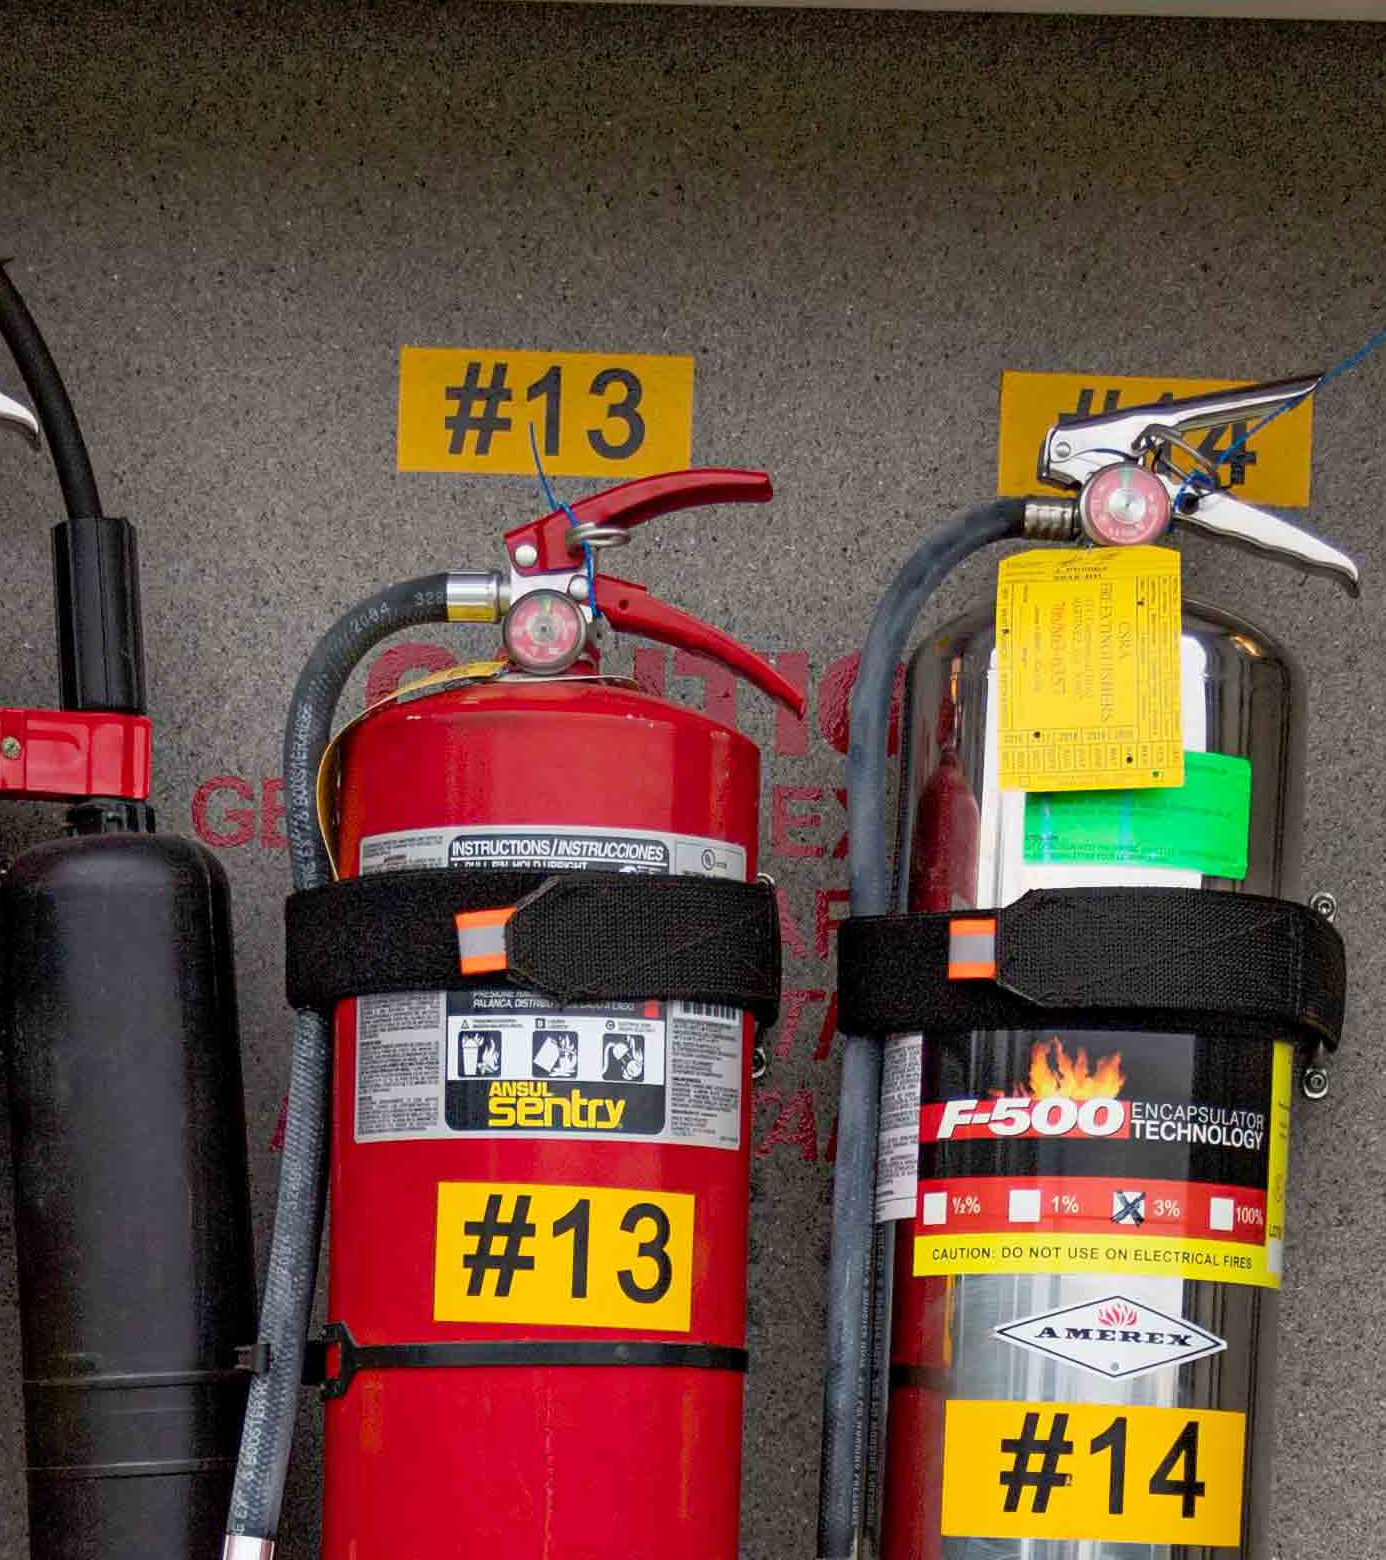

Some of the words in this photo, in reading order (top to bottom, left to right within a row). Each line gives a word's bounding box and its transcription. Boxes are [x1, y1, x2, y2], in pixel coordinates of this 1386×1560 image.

[444, 361, 646, 460] #13
[488, 1081, 551, 1098] ANSUL
[936, 1096, 1127, 1140] F-500
[1131, 1102, 1265, 1128] ENCAPSULATOR
[1130, 1120, 1263, 1150] TECHNOLOGY
[1051, 1195, 1080, 1214] 1%
[1153, 1199, 1181, 1217] 3%
[1235, 1206, 1263, 1225] 100%
[463, 1193, 673, 1304] #13
[932, 1247, 995, 1261] CAUTION:
[1001, 1246, 1023, 1258] DO
[1029, 1247, 1060, 1259] NOT
[1068, 1248, 1097, 1260] USE
[1105, 1248, 1127, 1261] ON
[1133, 1249, 1220, 1267] ELECTRICAL
[1223, 1255, 1252, 1270] FIRES
[1034, 1326, 1194, 1347] AMEREX
[999, 1412, 1205, 1519] #14
